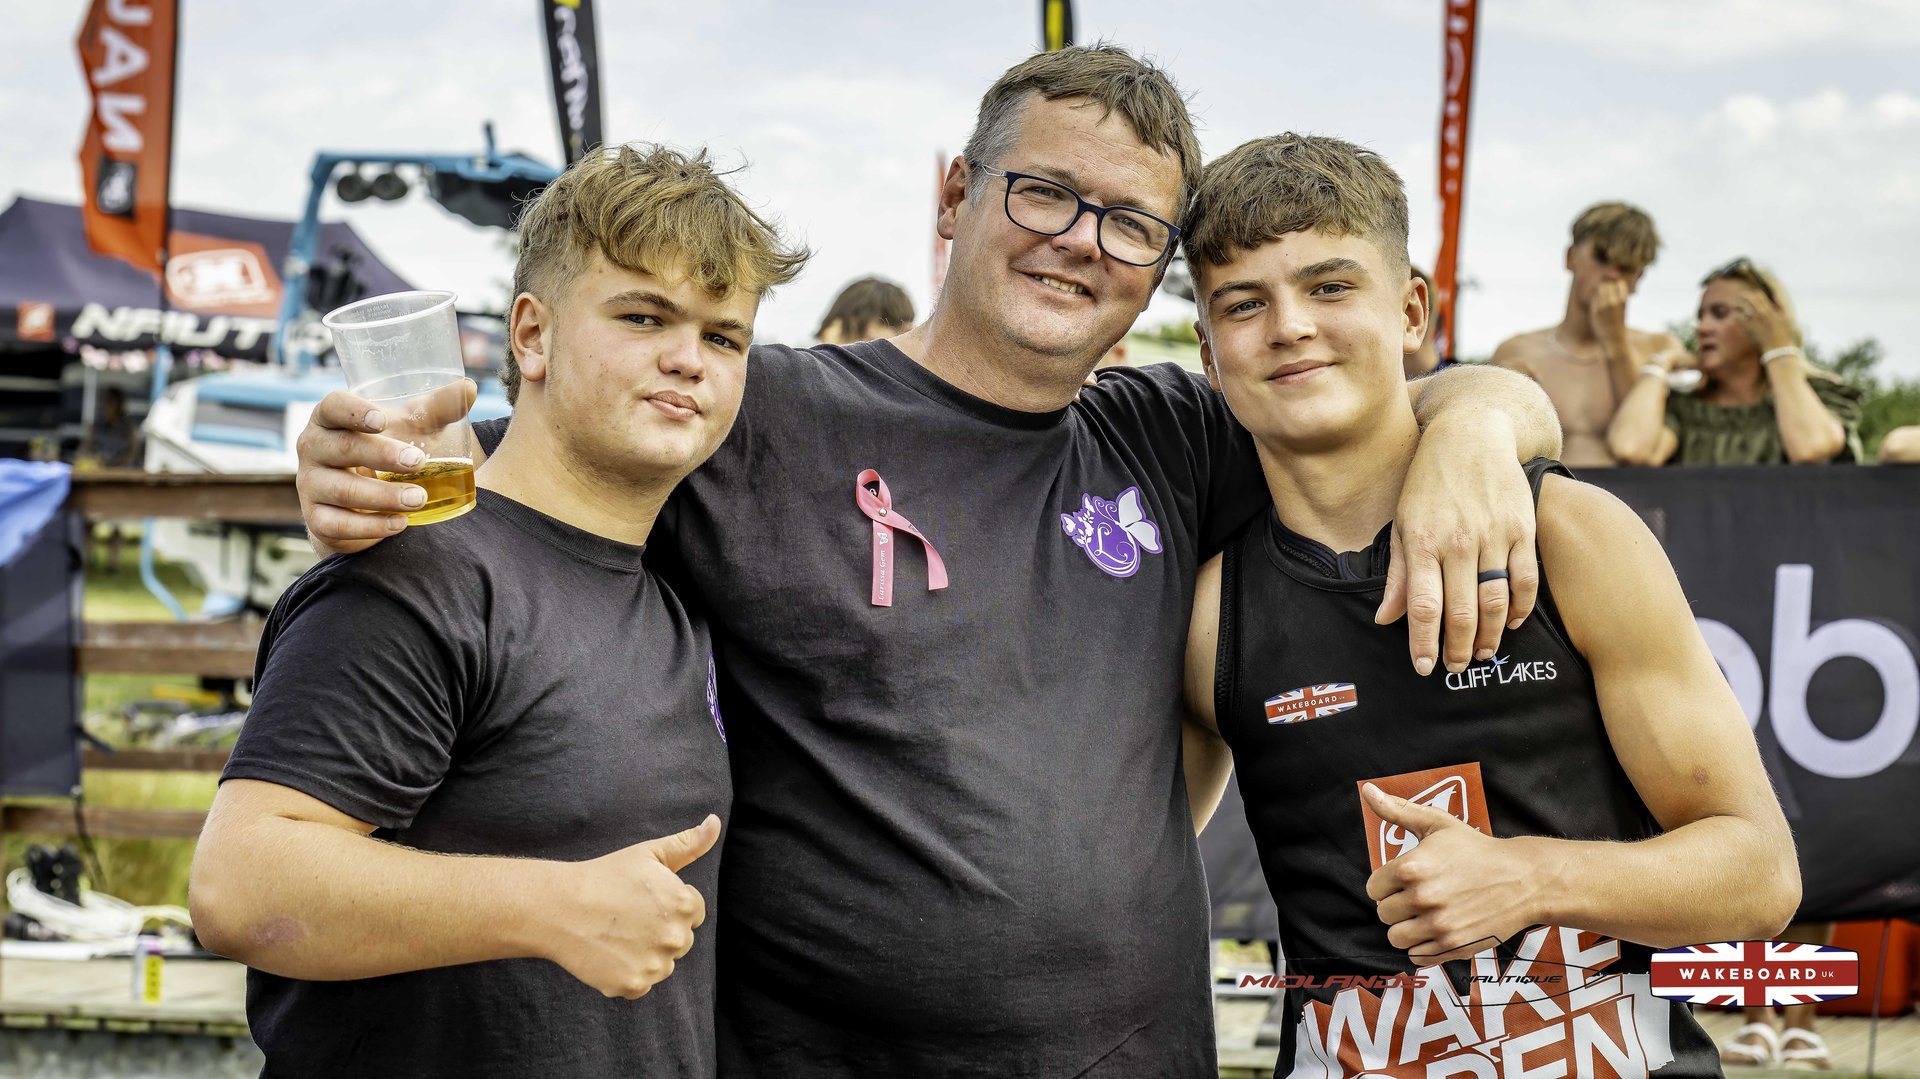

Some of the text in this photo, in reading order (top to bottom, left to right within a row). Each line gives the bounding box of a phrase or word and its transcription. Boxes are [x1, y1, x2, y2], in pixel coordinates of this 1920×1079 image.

[878, 569, 886, 601] Larissa
[1445, 661, 1557, 690] CLIFF LAKES
[1277, 696, 1337, 713] WAKEBOARD
[1303, 925, 1622, 1071] WAKE
